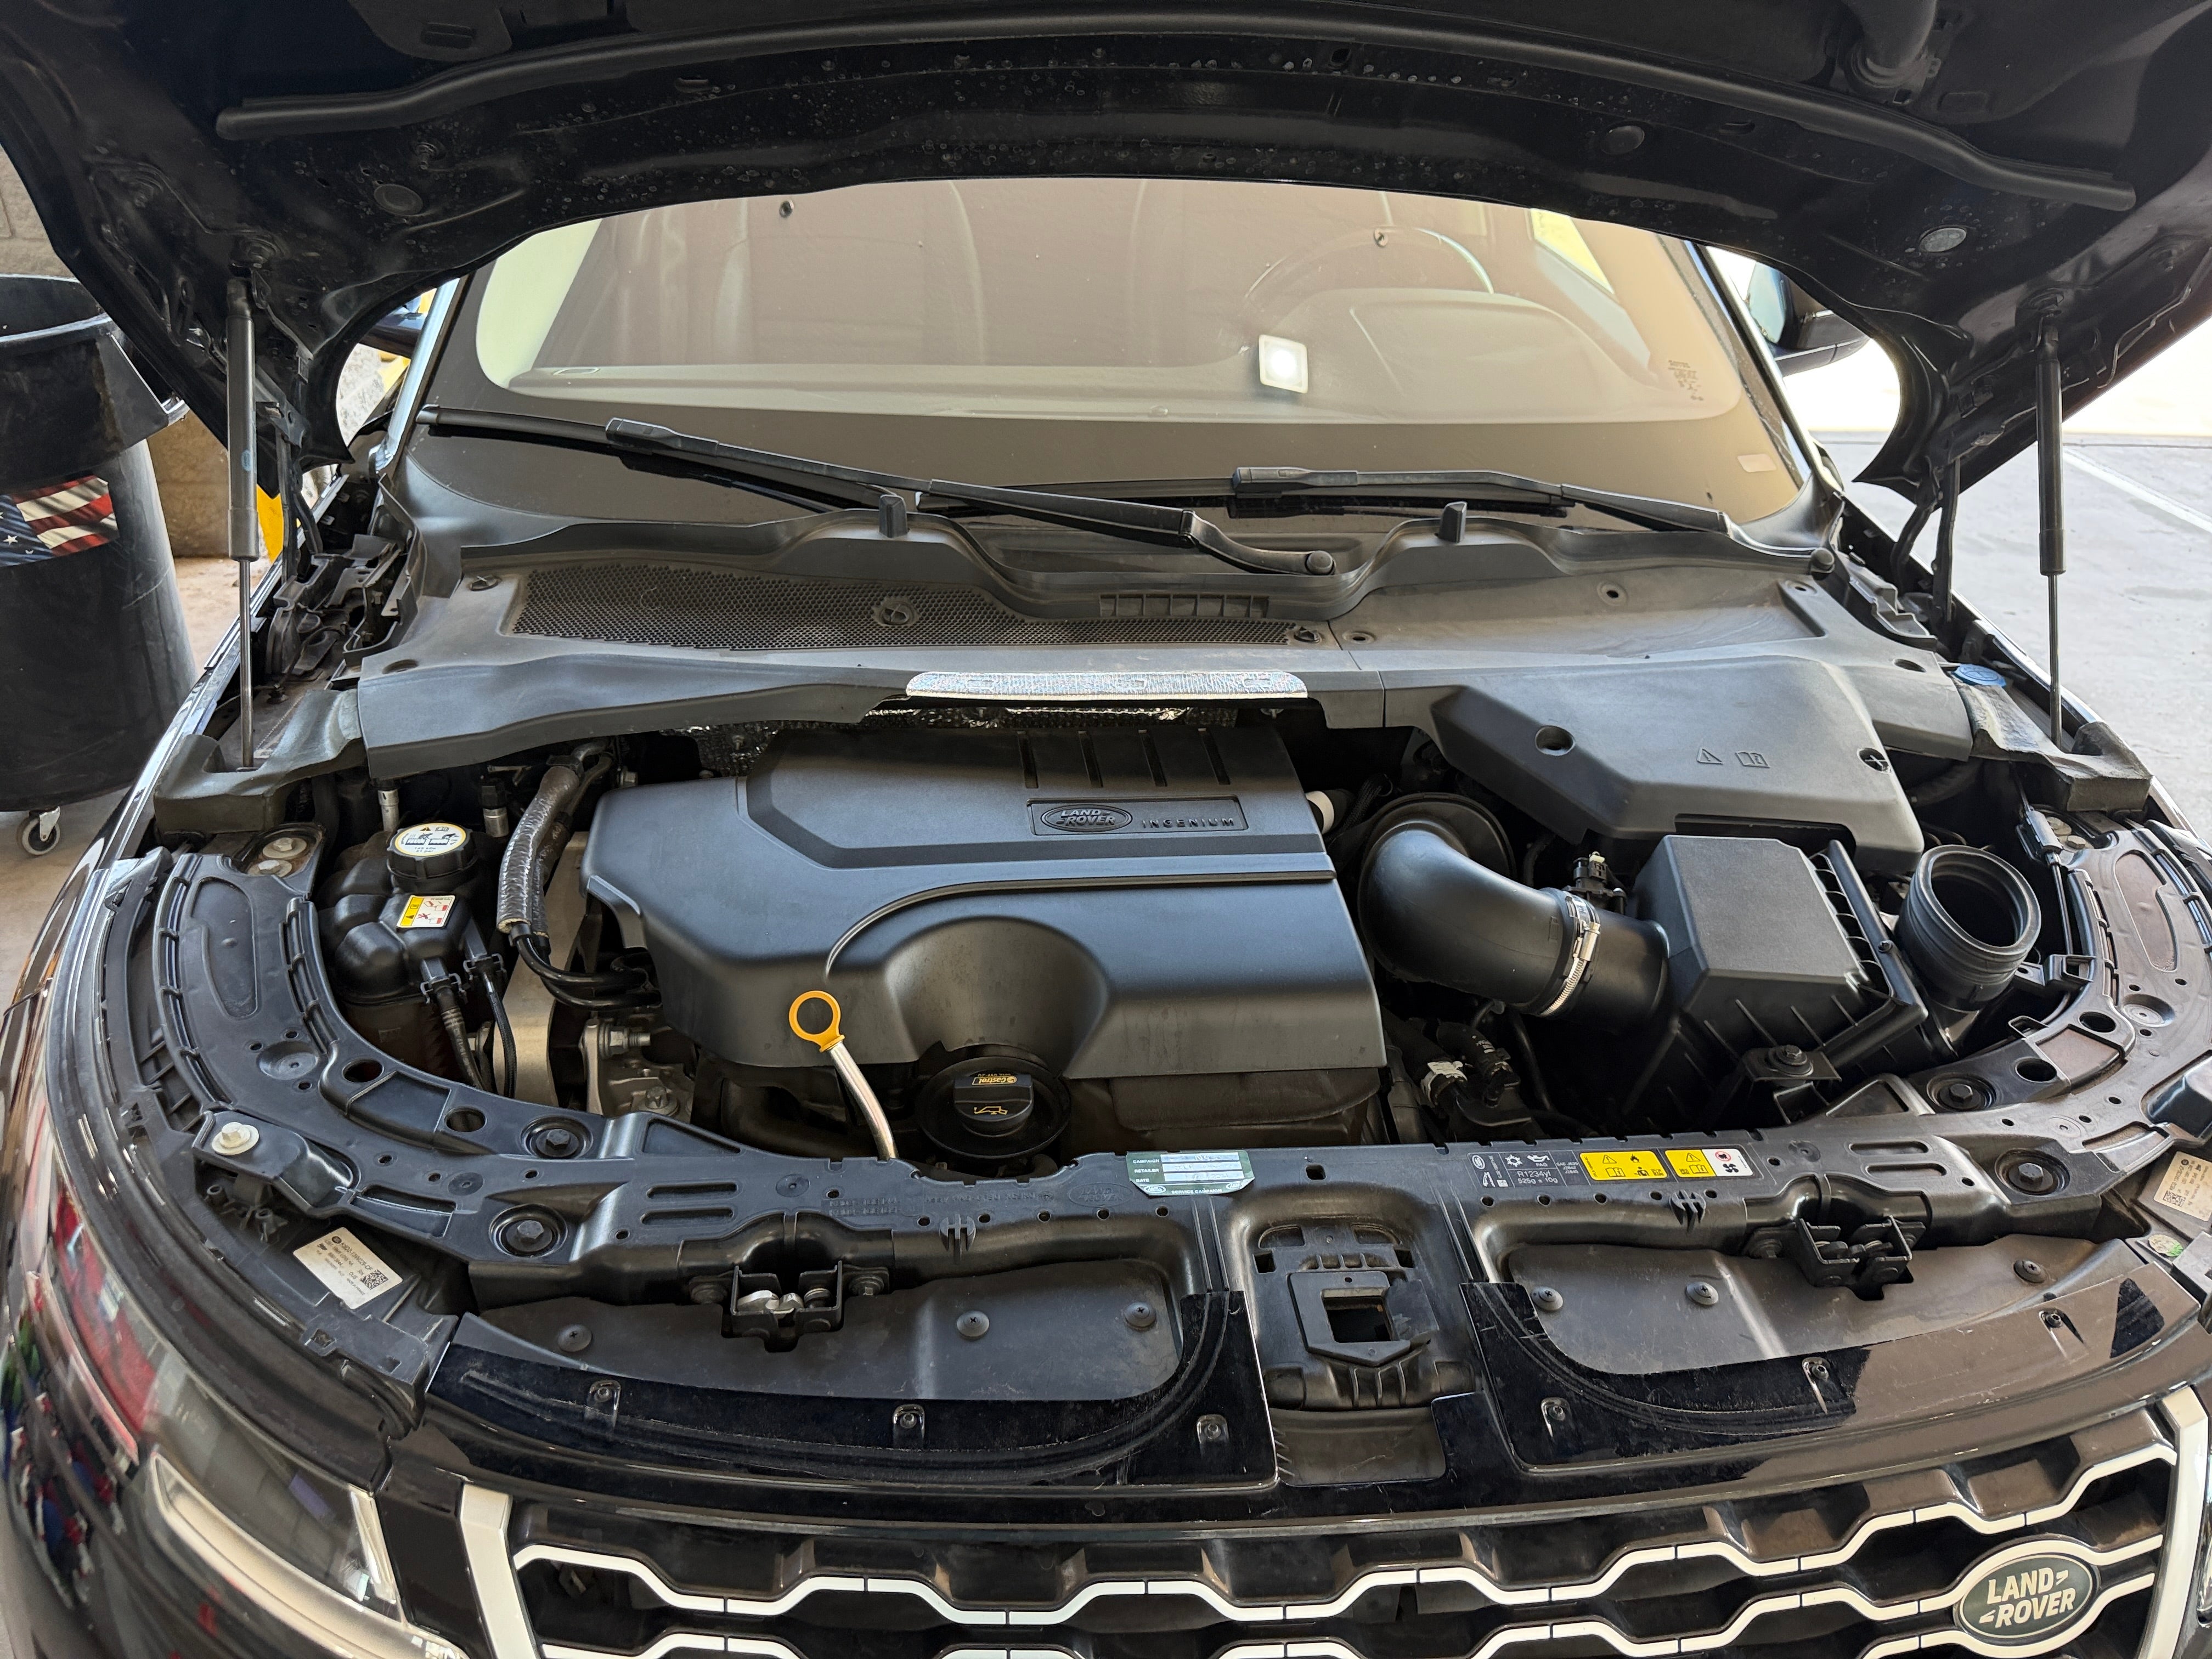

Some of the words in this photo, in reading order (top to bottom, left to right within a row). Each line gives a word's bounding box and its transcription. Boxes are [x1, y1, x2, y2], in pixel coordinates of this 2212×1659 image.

[1060, 809, 1101, 817] LAND
[1063, 816, 1116, 826] ROVER
[1142, 817, 1235, 828] INGENIUM
[1517, 1170, 1552, 1178] R1234yf
[1987, 1567, 2054, 1605] LAND
[1994, 1587, 2076, 1629] ROVER
